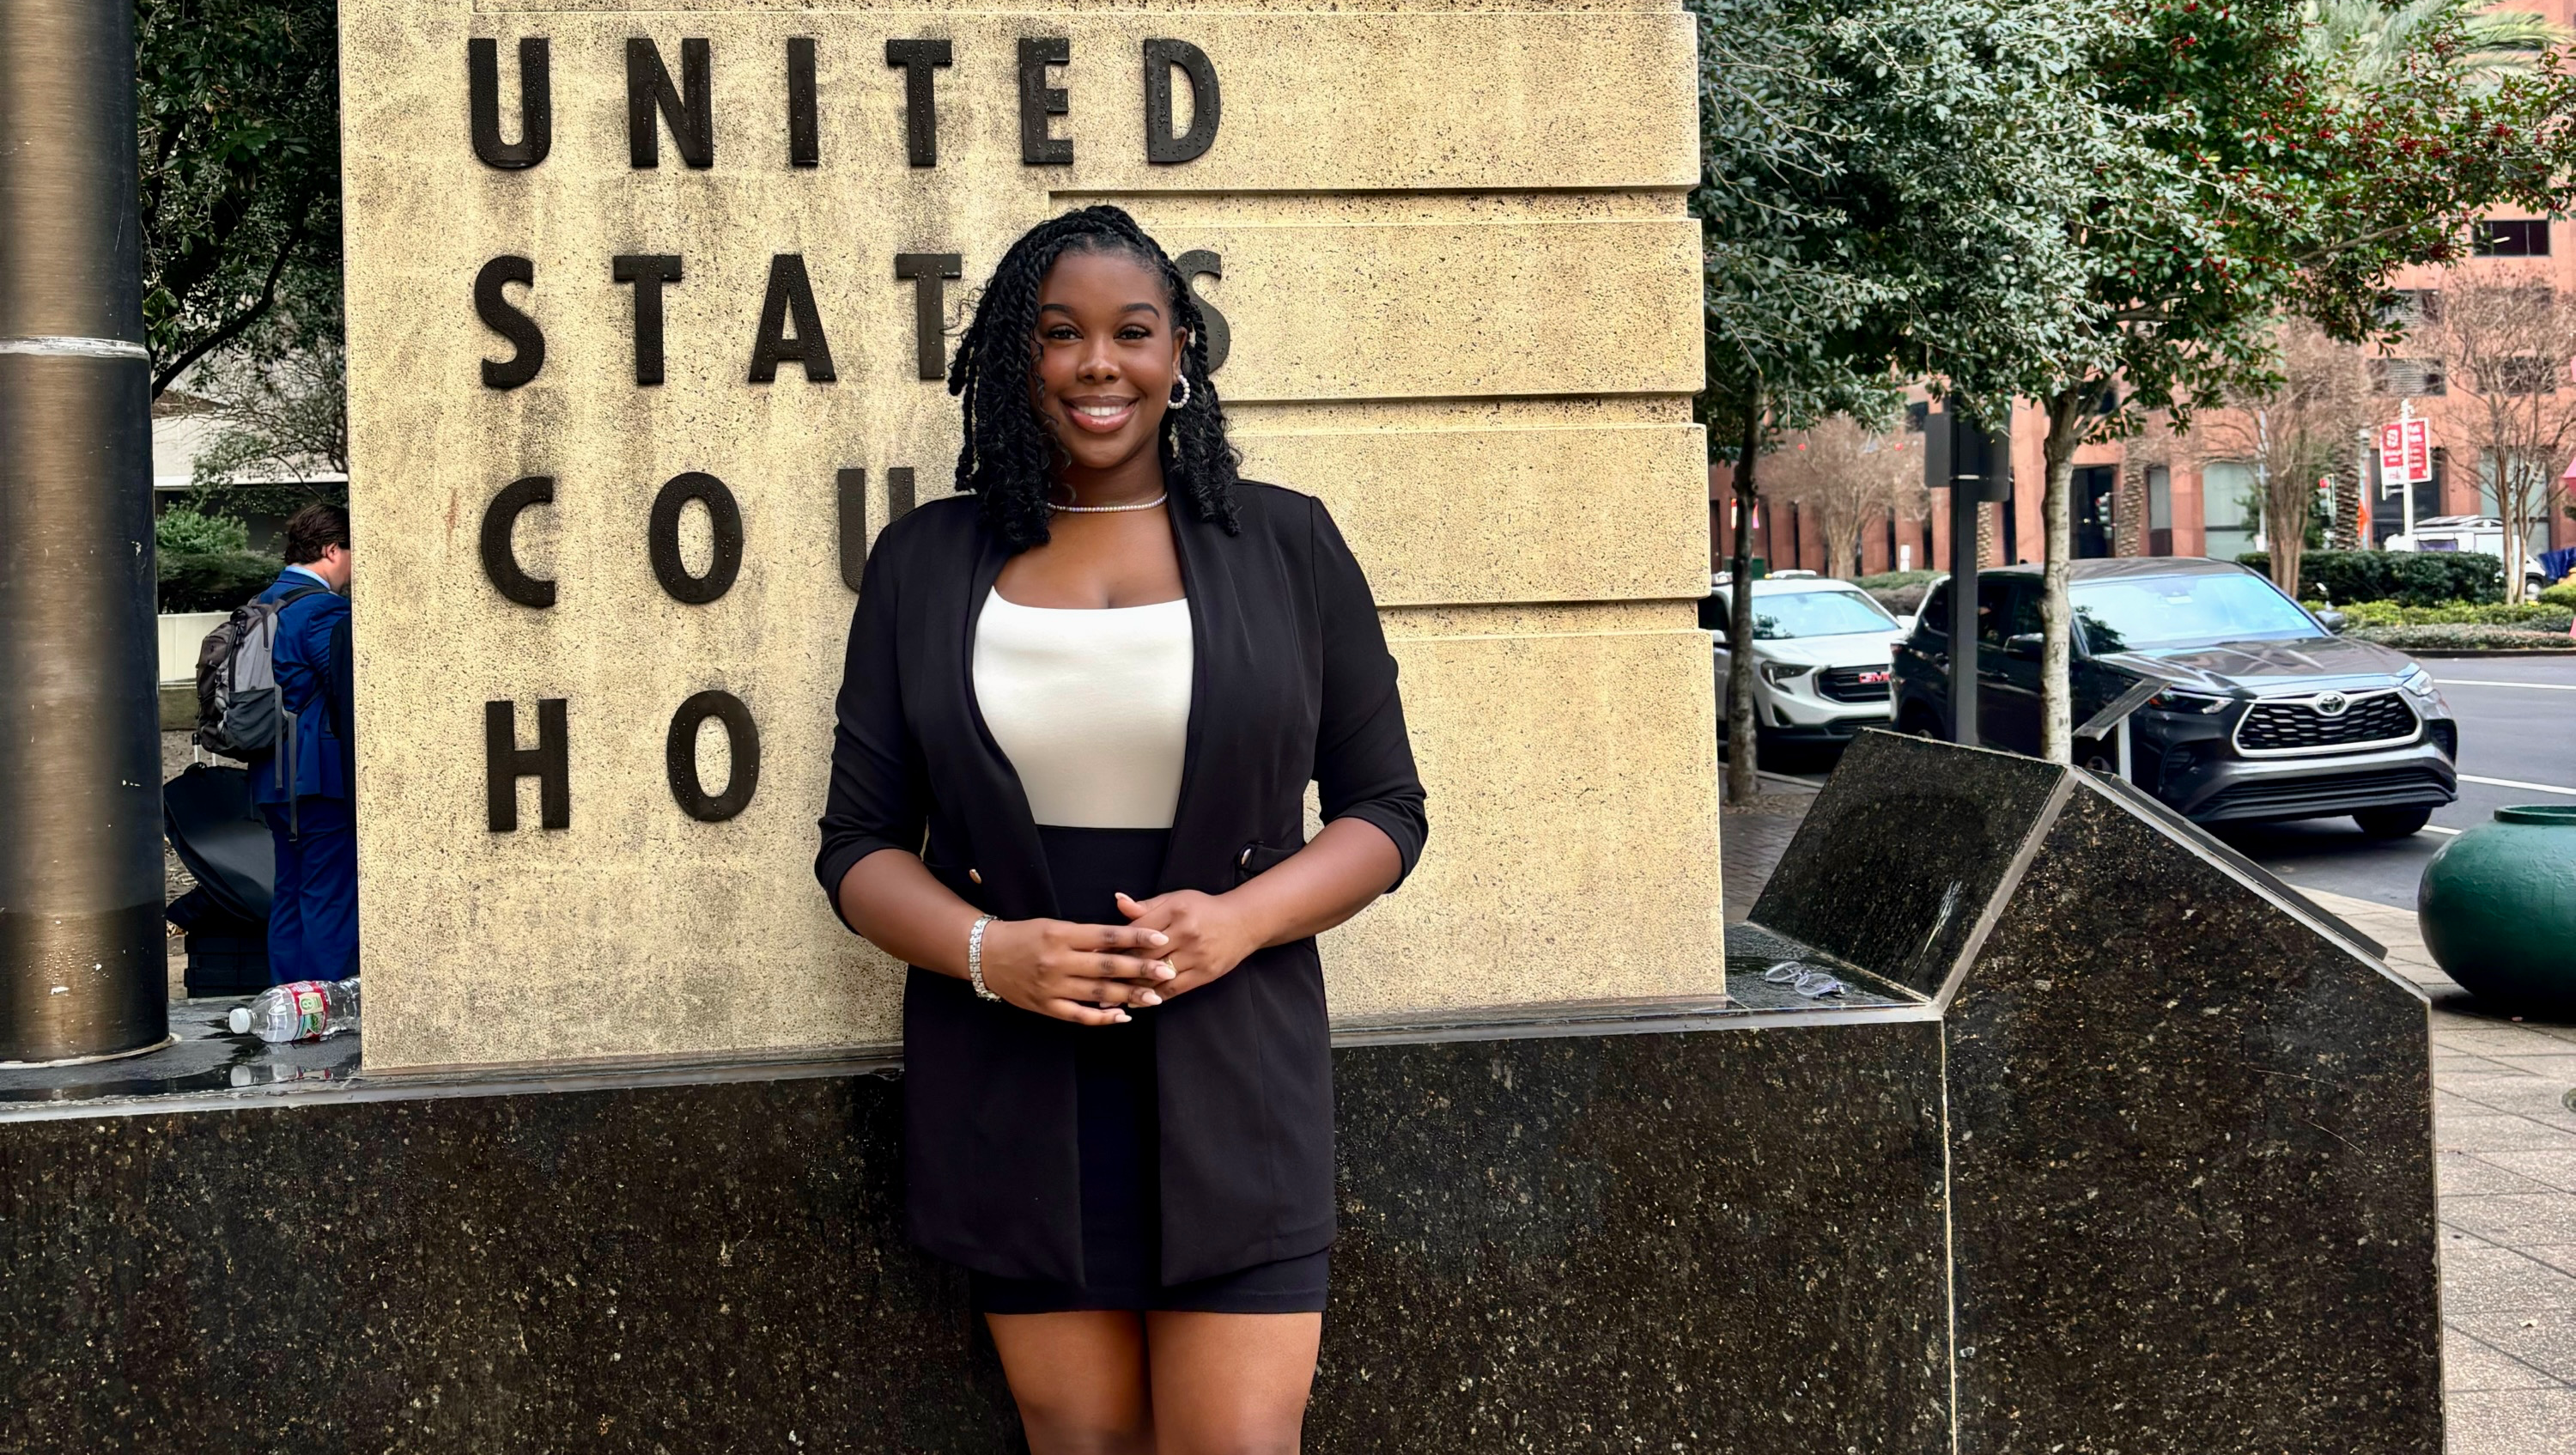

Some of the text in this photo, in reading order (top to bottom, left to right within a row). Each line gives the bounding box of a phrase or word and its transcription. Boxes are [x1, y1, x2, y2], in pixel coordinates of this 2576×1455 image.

[469, 38, 1222, 168] UNITED
[474, 250, 1231, 390] STATS
[482, 467, 915, 608] COU
